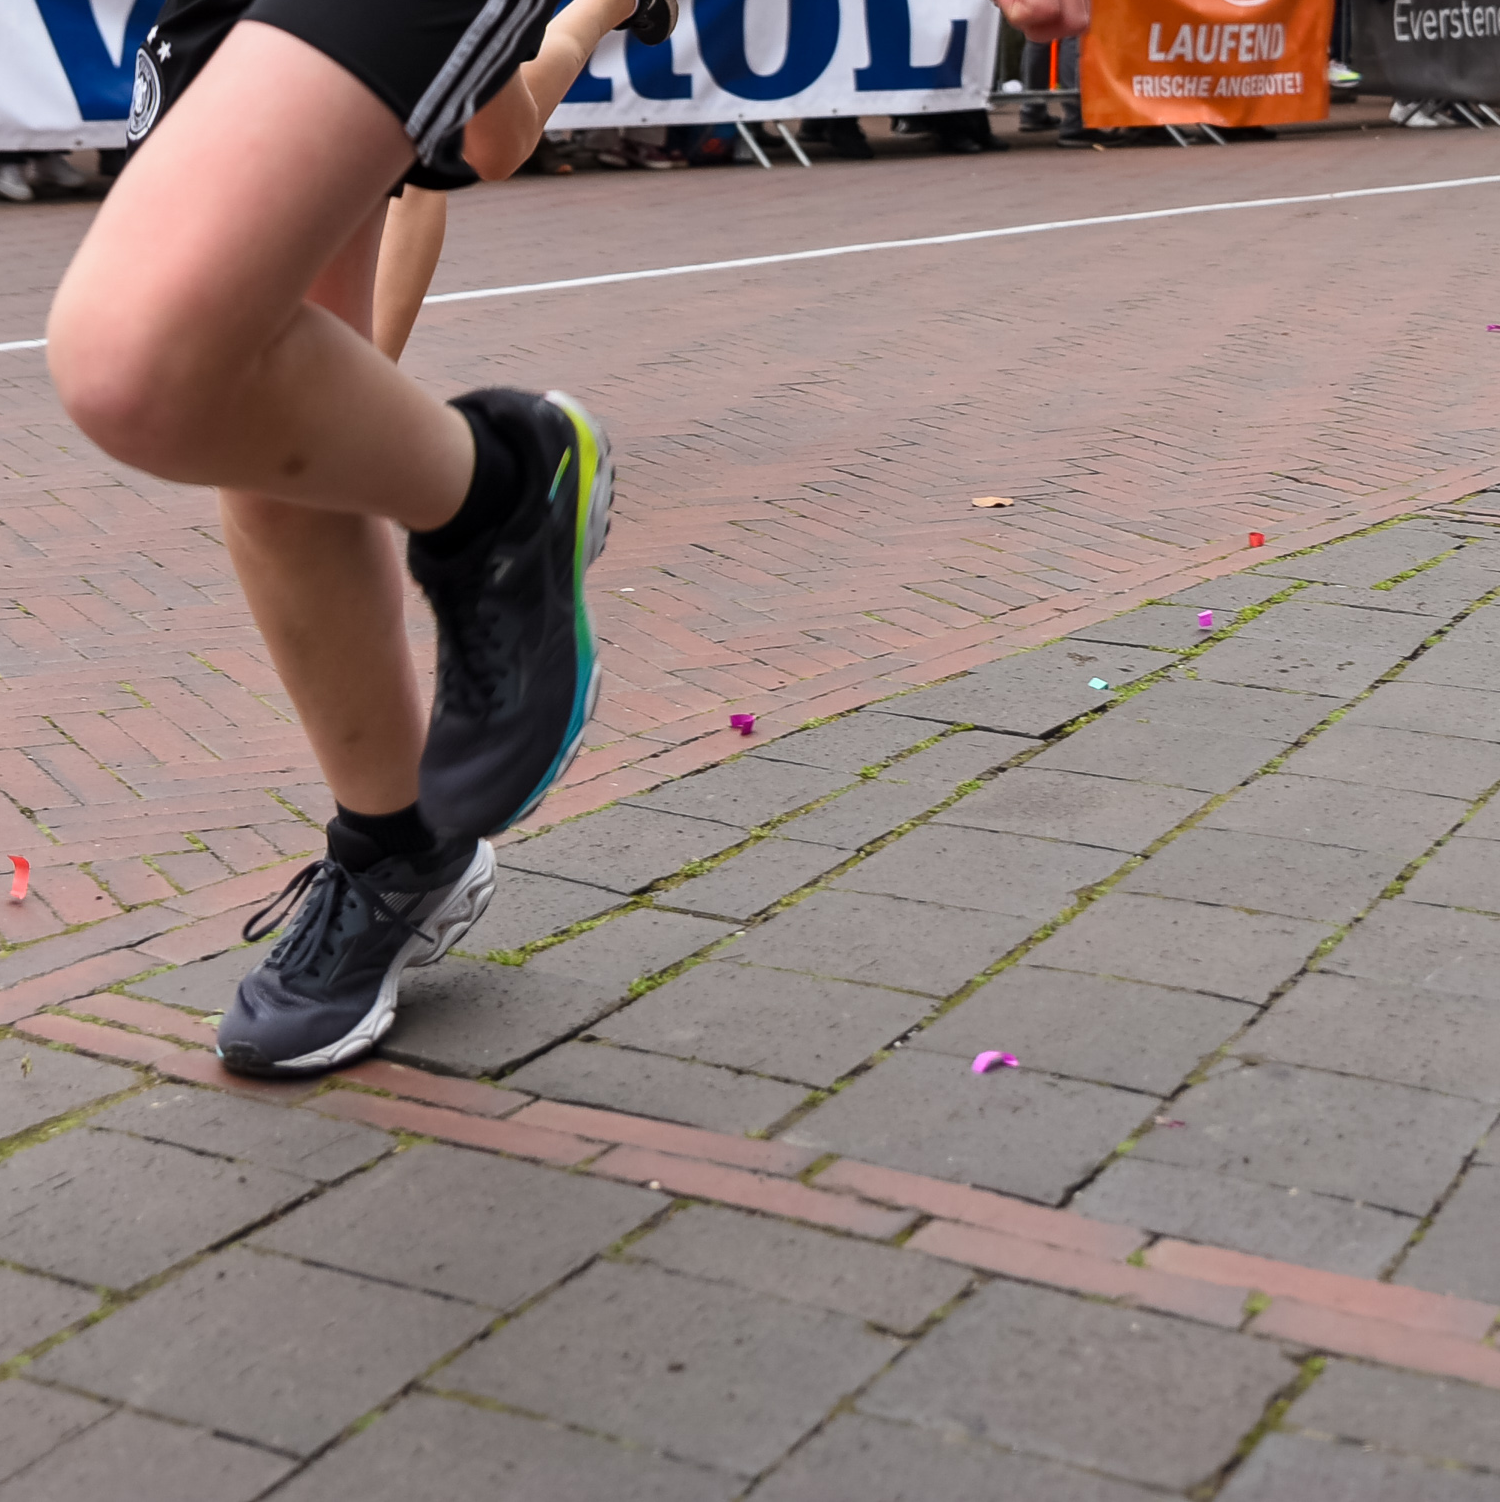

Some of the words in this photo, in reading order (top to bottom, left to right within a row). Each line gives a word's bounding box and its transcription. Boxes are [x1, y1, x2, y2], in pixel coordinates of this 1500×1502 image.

[1148, 23, 1285, 63] LAUFEND
[1132, 74, 1212, 97] FRISCHE
[1214, 72, 1302, 97] ANGEBOTE!
